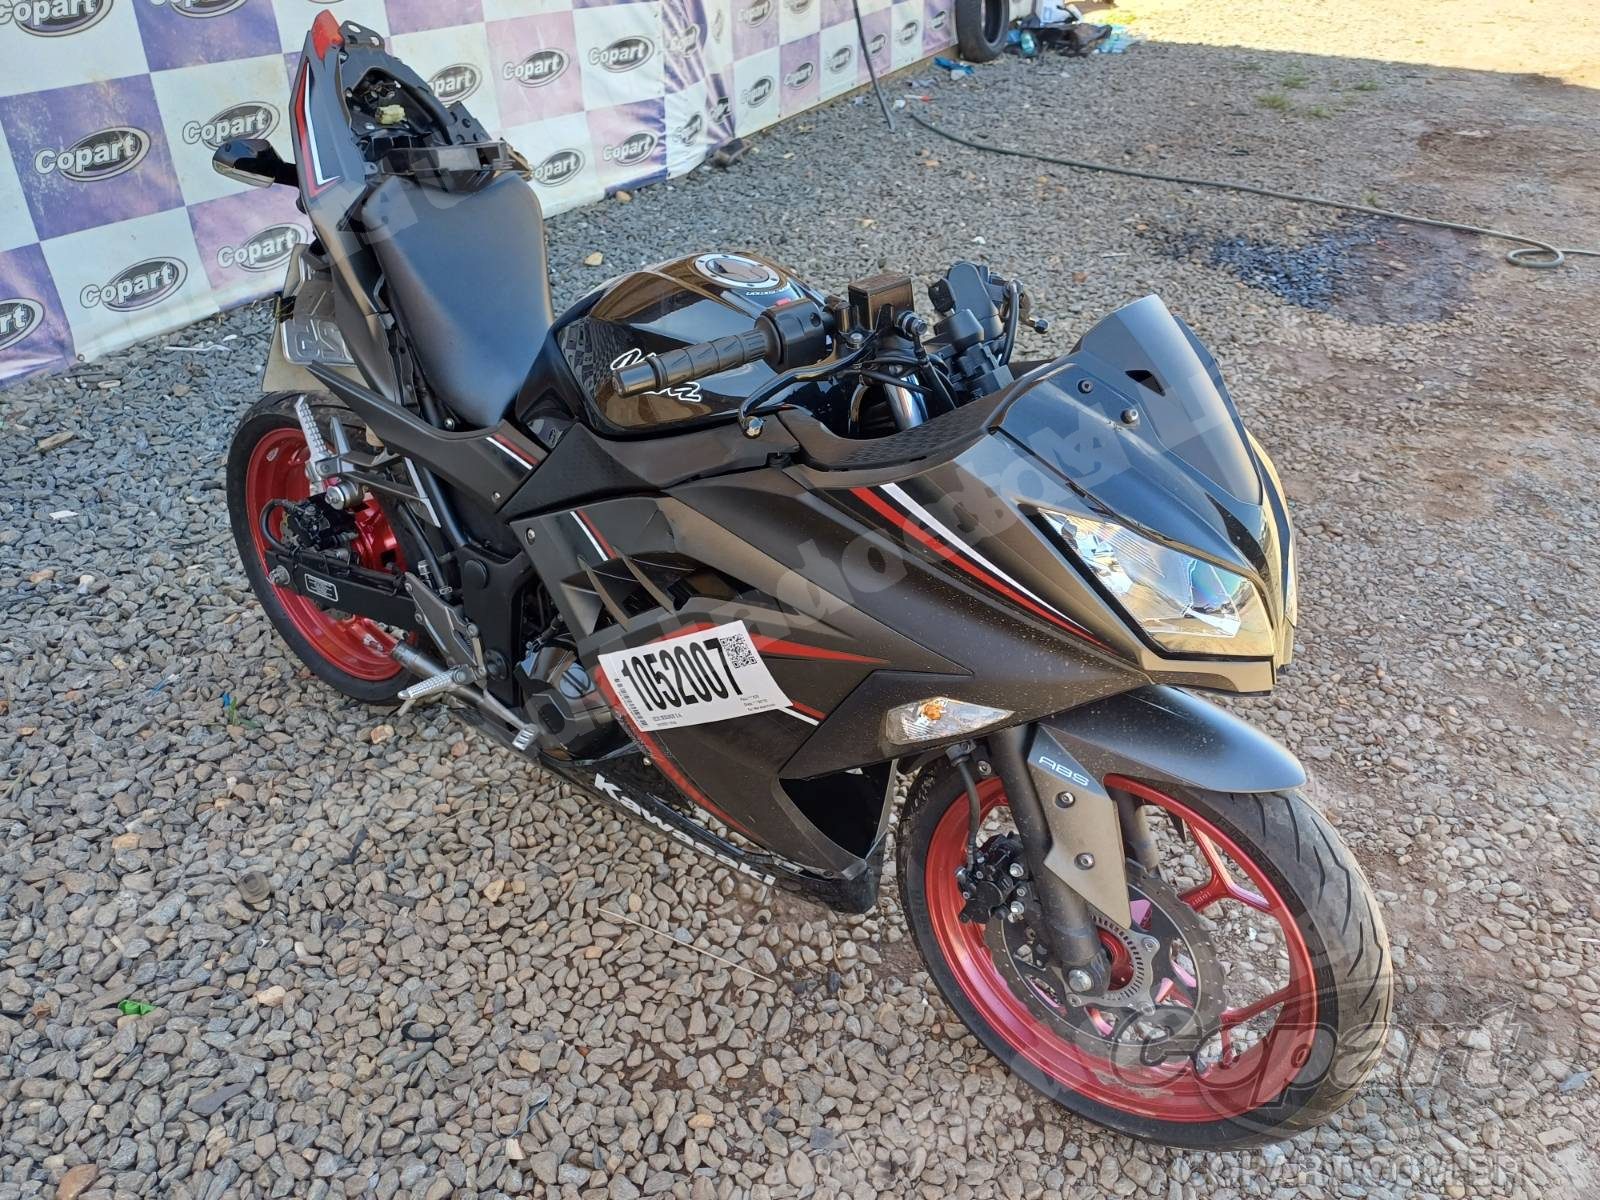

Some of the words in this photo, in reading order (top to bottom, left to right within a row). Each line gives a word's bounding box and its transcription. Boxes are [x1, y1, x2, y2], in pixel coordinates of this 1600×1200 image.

[503, 51, 560, 81] Copart
[589, 38, 645, 66] Copart
[427, 70, 472, 98] part
[183, 106, 267, 145] Copart
[35, 133, 137, 175] Copart
[602, 134, 651, 162] Copart
[217, 229, 297, 268] Copart
[80, 262, 174, 309] Copart
[621, 637, 743, 712] 1052007
[1038, 756, 1089, 786] ABS
